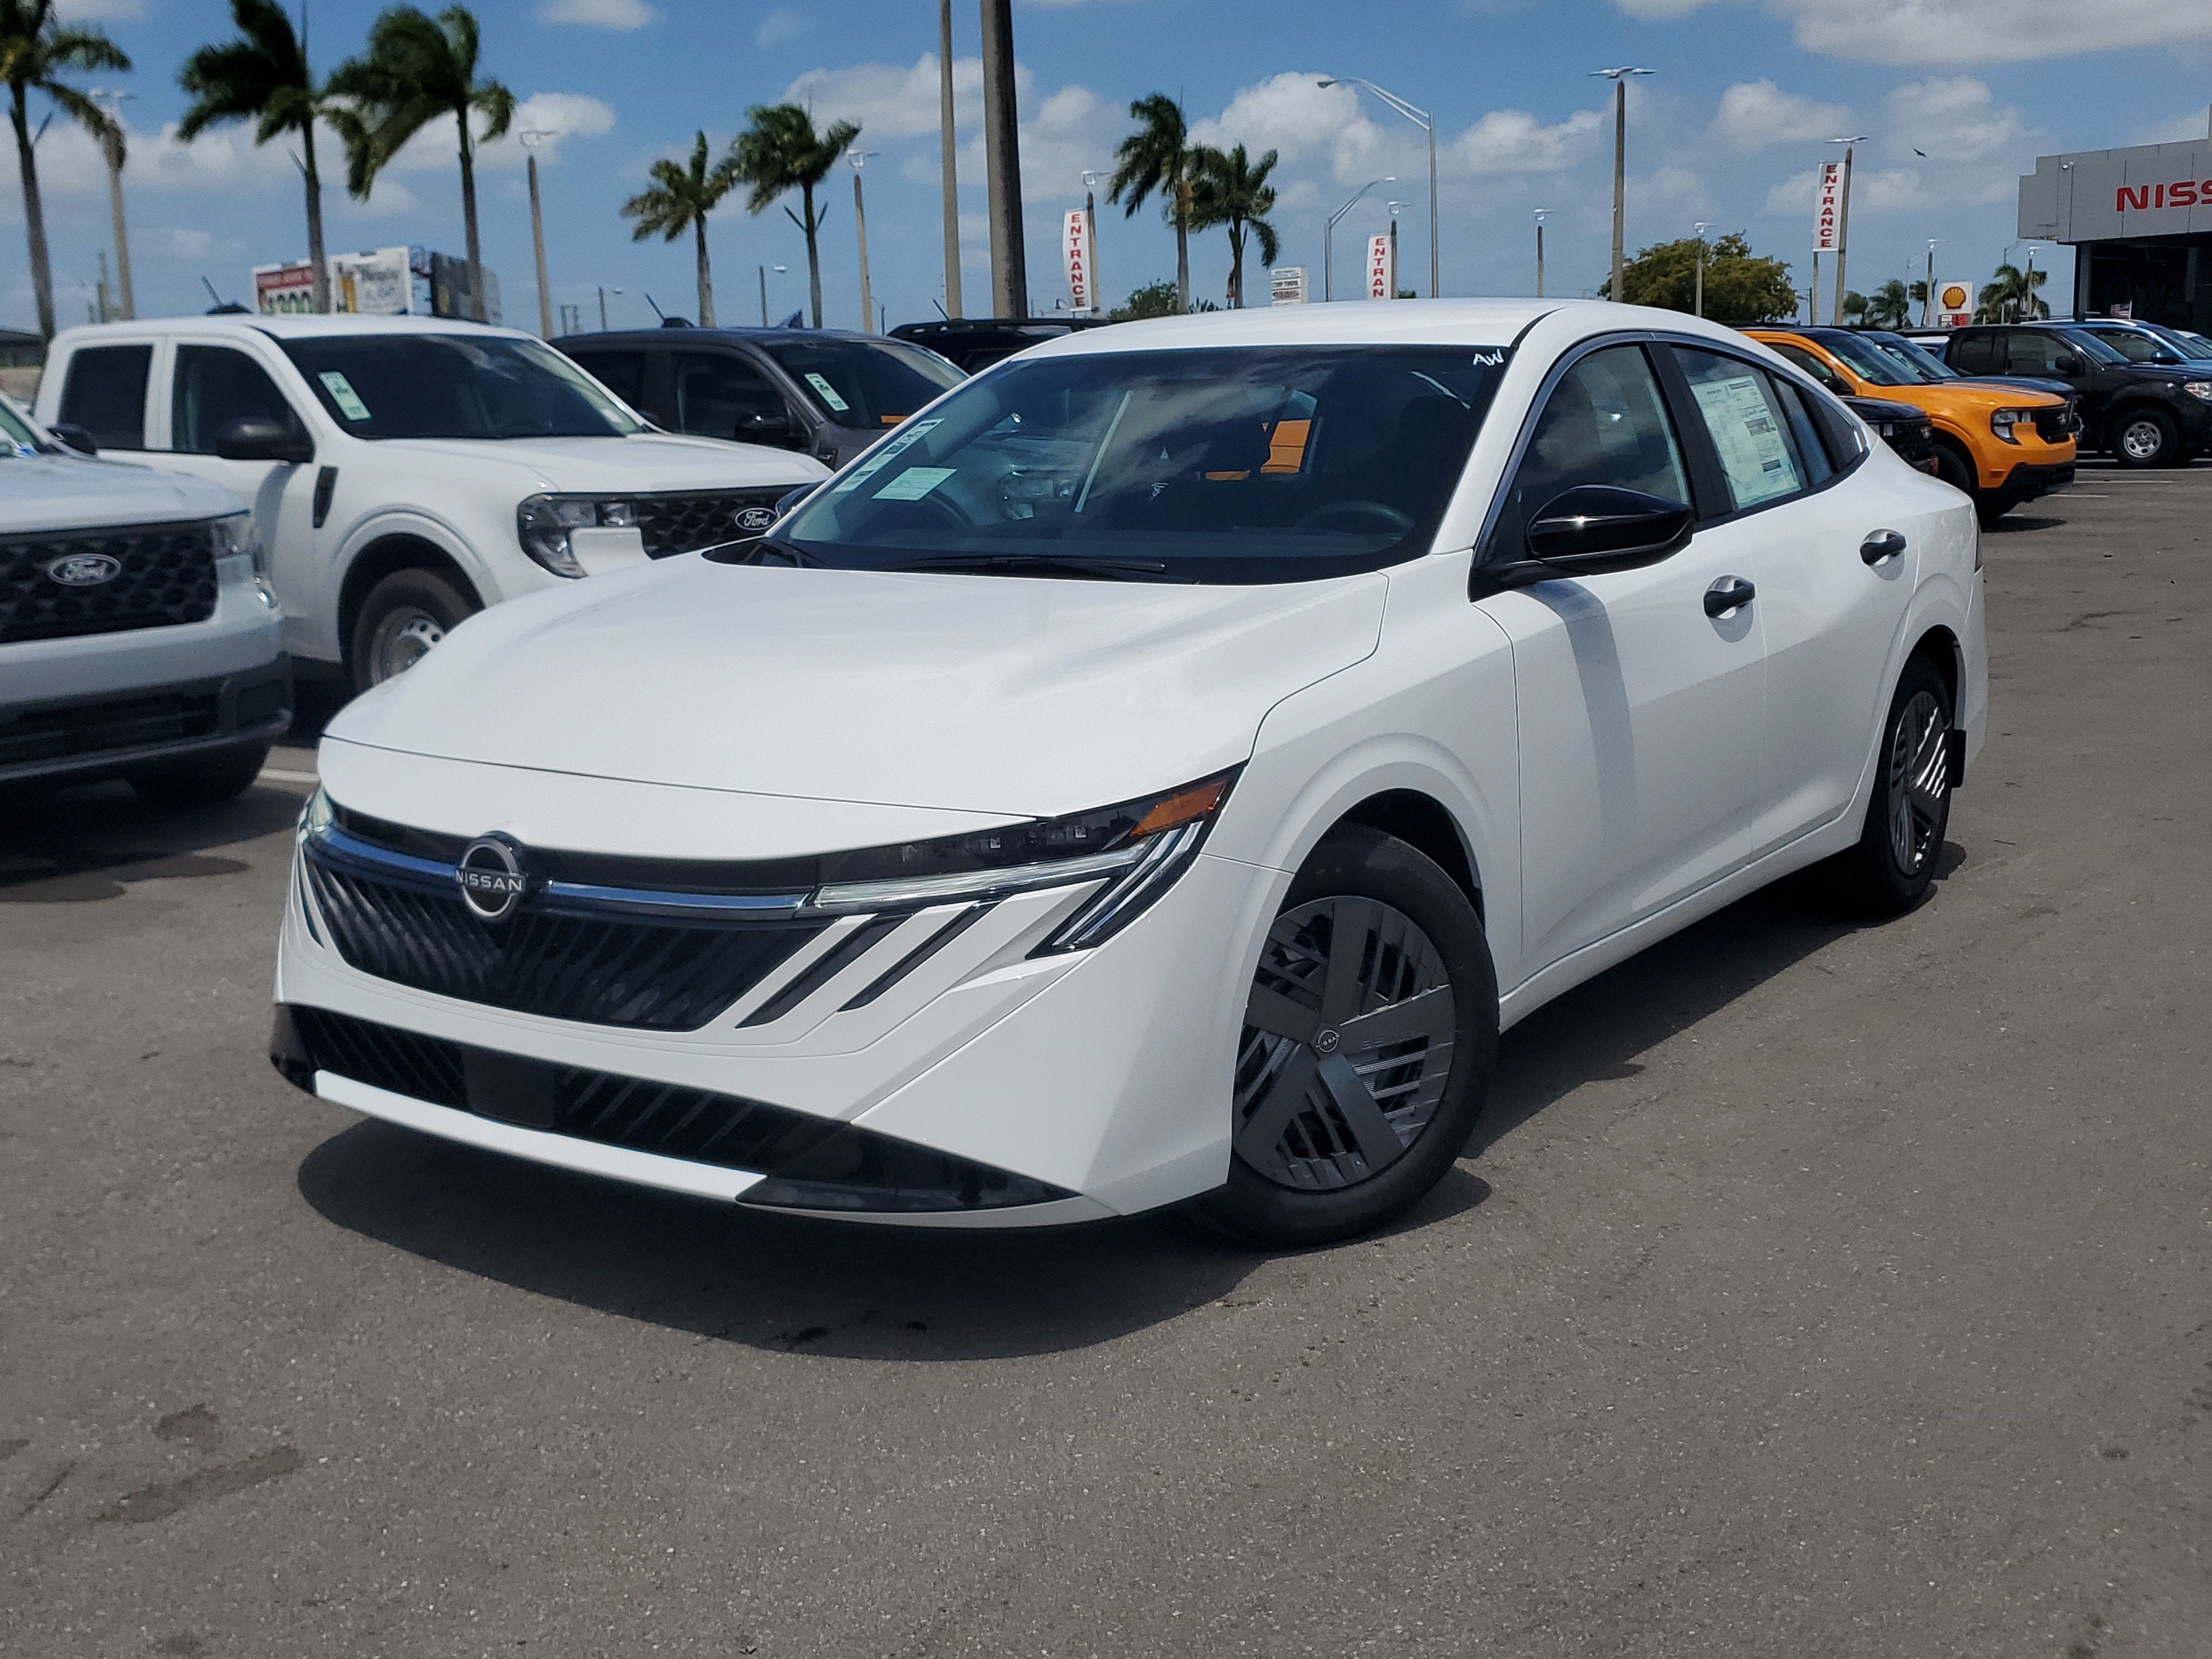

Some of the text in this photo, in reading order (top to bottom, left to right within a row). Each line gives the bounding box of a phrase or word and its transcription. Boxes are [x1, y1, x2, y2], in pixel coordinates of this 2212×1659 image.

[1820, 165, 1837, 247] ENTRANCE
[1070, 213, 1085, 307] ENTRANCE
[743, 511, 770, 527] Ford
[455, 869, 522, 892] NISSAN
